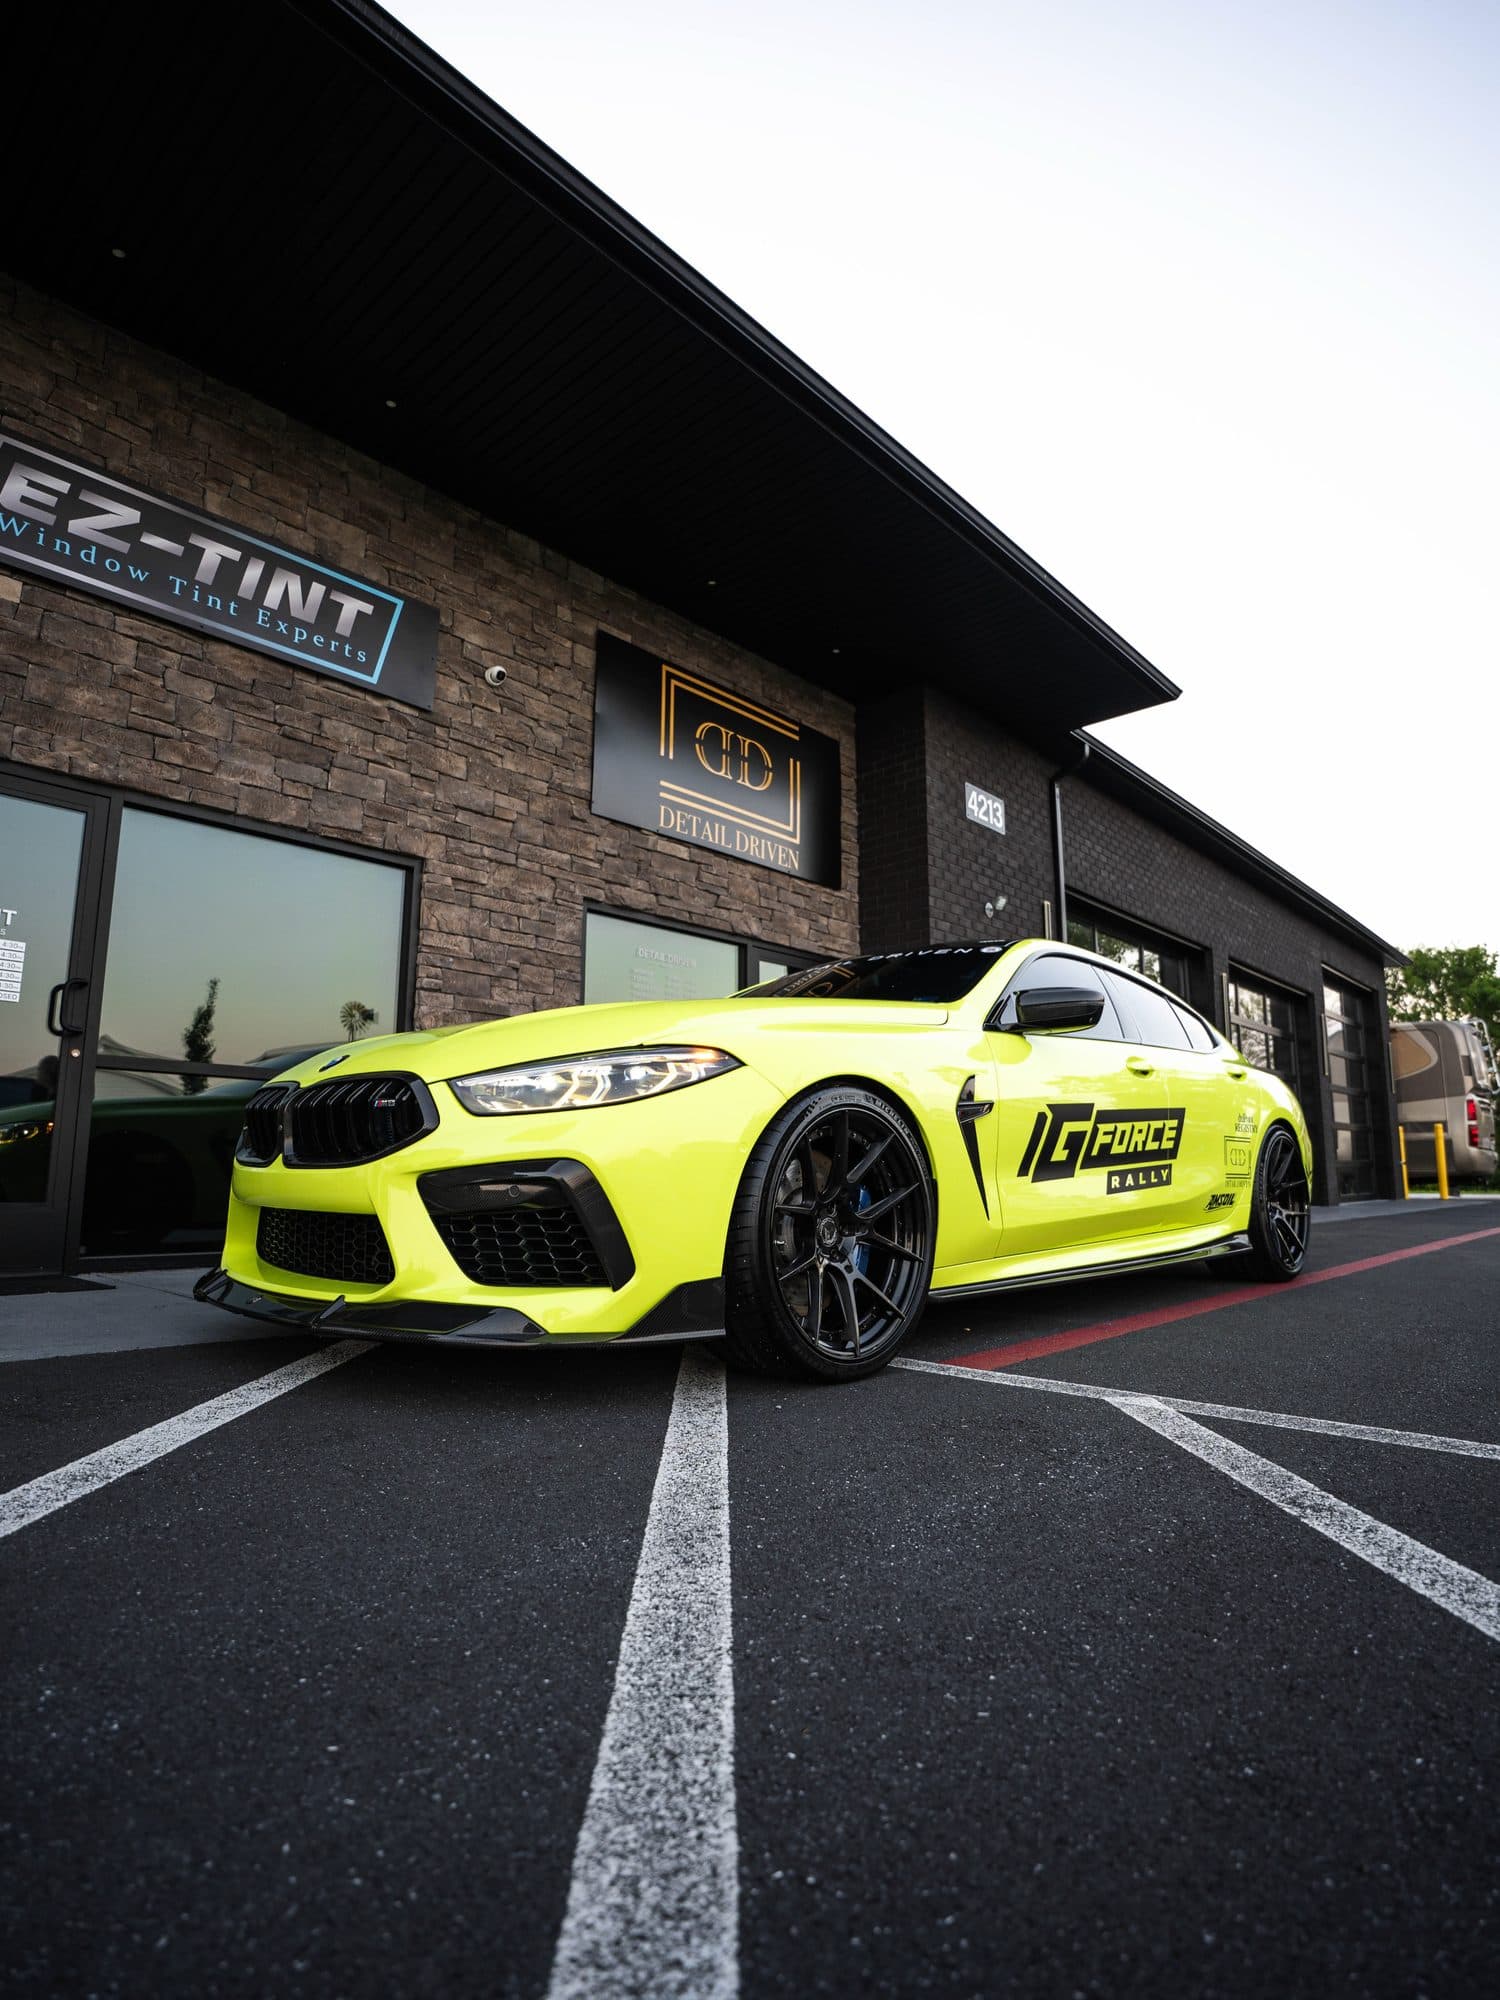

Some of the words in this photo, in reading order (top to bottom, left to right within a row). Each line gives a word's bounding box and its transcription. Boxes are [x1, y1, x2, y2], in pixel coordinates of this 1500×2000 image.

[0, 462, 374, 637] EZ-TINT
[0, 512, 150, 582] Window
[169, 575, 239, 616] Tint
[255, 608, 367, 663] Experts
[968, 790, 1003, 828] 4213
[659, 805, 732, 849] DETAIL
[736, 830, 799, 871] DRIVEN
[1091, 1119, 1178, 1157] FORCE
[1111, 1168, 1169, 1189] RALLY
[1205, 1193, 1235, 1209] AMSOIL
